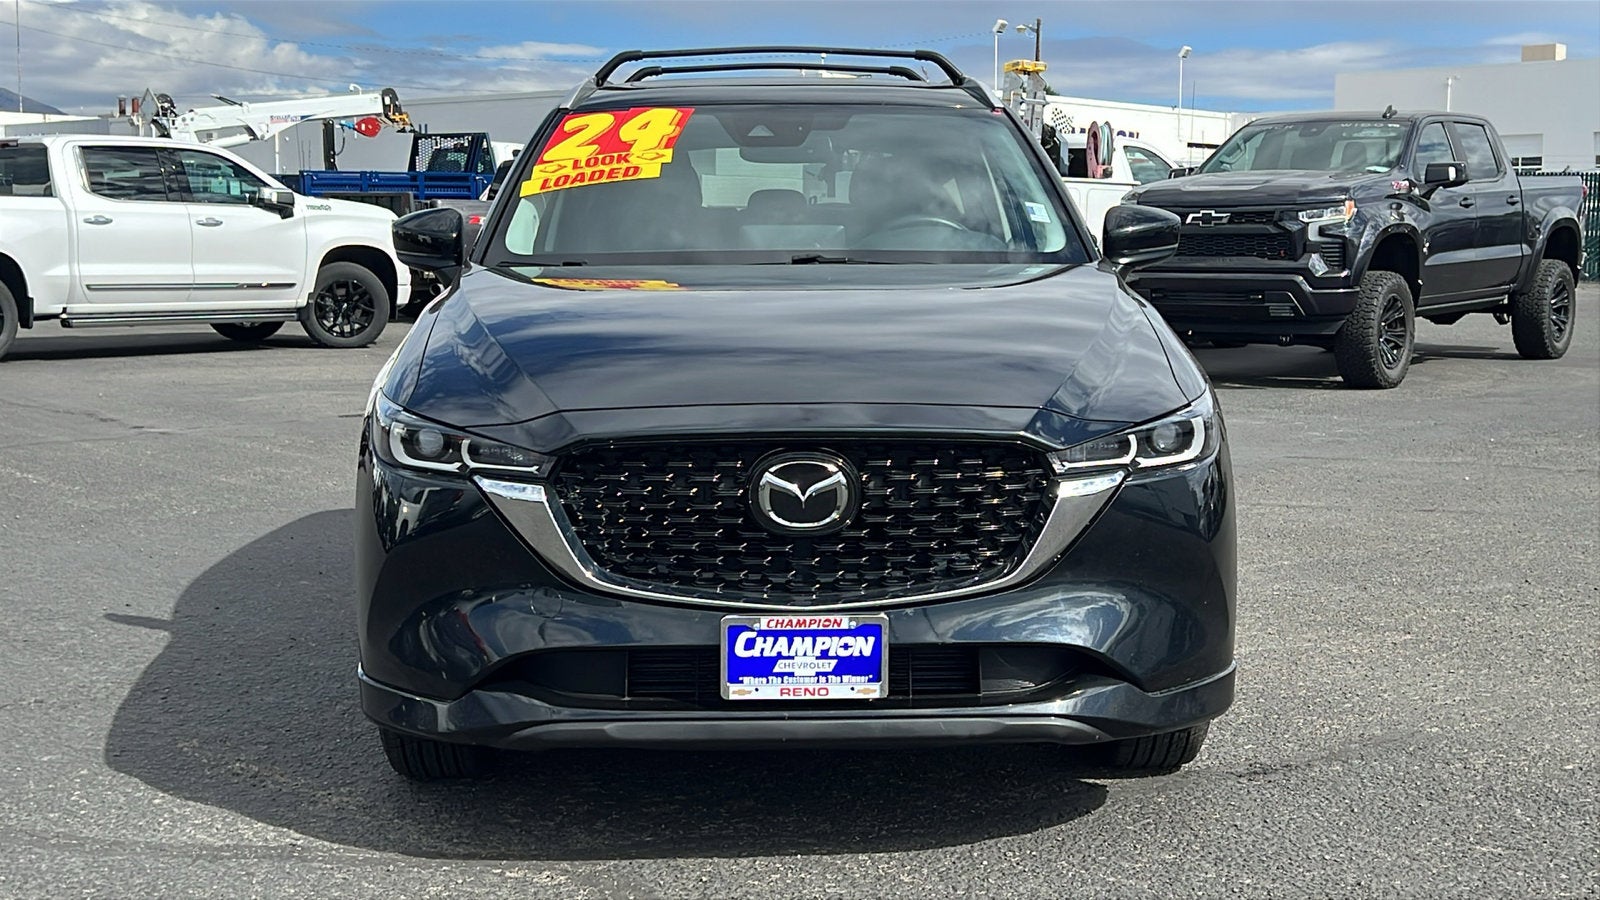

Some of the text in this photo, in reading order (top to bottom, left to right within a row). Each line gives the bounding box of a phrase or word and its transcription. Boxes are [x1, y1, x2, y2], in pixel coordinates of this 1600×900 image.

[543, 108, 682, 161] 24
[572, 153, 632, 170] LOOK
[539, 165, 642, 190] LOADED
[766, 618, 843, 628] CHAMPION
[734, 631, 876, 658] CHAMPION
[777, 661, 832, 669] CHEVROLET
[780, 687, 829, 697] RENO
